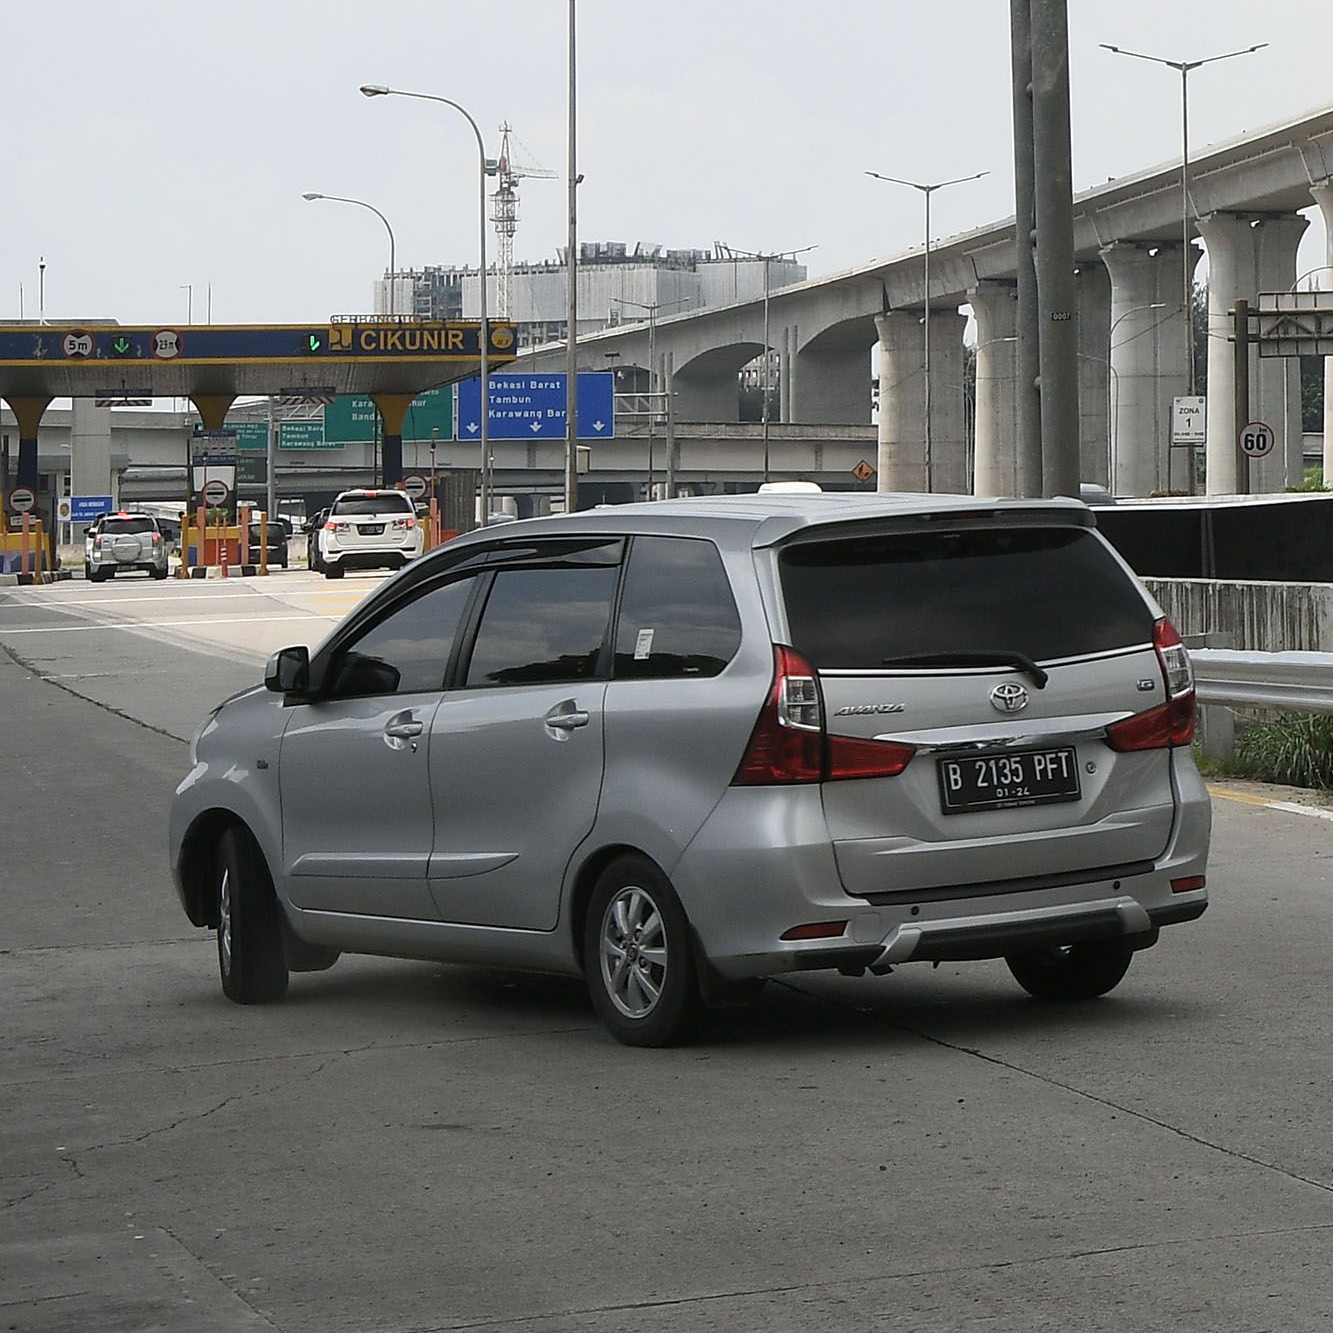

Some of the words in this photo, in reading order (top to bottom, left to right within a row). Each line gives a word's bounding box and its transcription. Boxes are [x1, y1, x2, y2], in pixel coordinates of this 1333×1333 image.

[68, 340, 76, 351] 5
[78, 342, 88, 351] m
[360, 329, 464, 351] CIKUNIR
[489, 381, 526, 390] Bekasi
[530, 381, 561, 390] Barat
[489, 395, 532, 404] Tambun
[488, 409, 543, 419] Karawang
[1178, 407, 1200, 415] ZONA
[1185, 417, 1191, 428] 1
[1244, 433, 1267, 451] 60
[834, 703, 905, 716] AVANZA
[948, 764, 962, 791] B
[975, 757, 1024, 787] 2135
[1033, 752, 1069, 781] PFT
